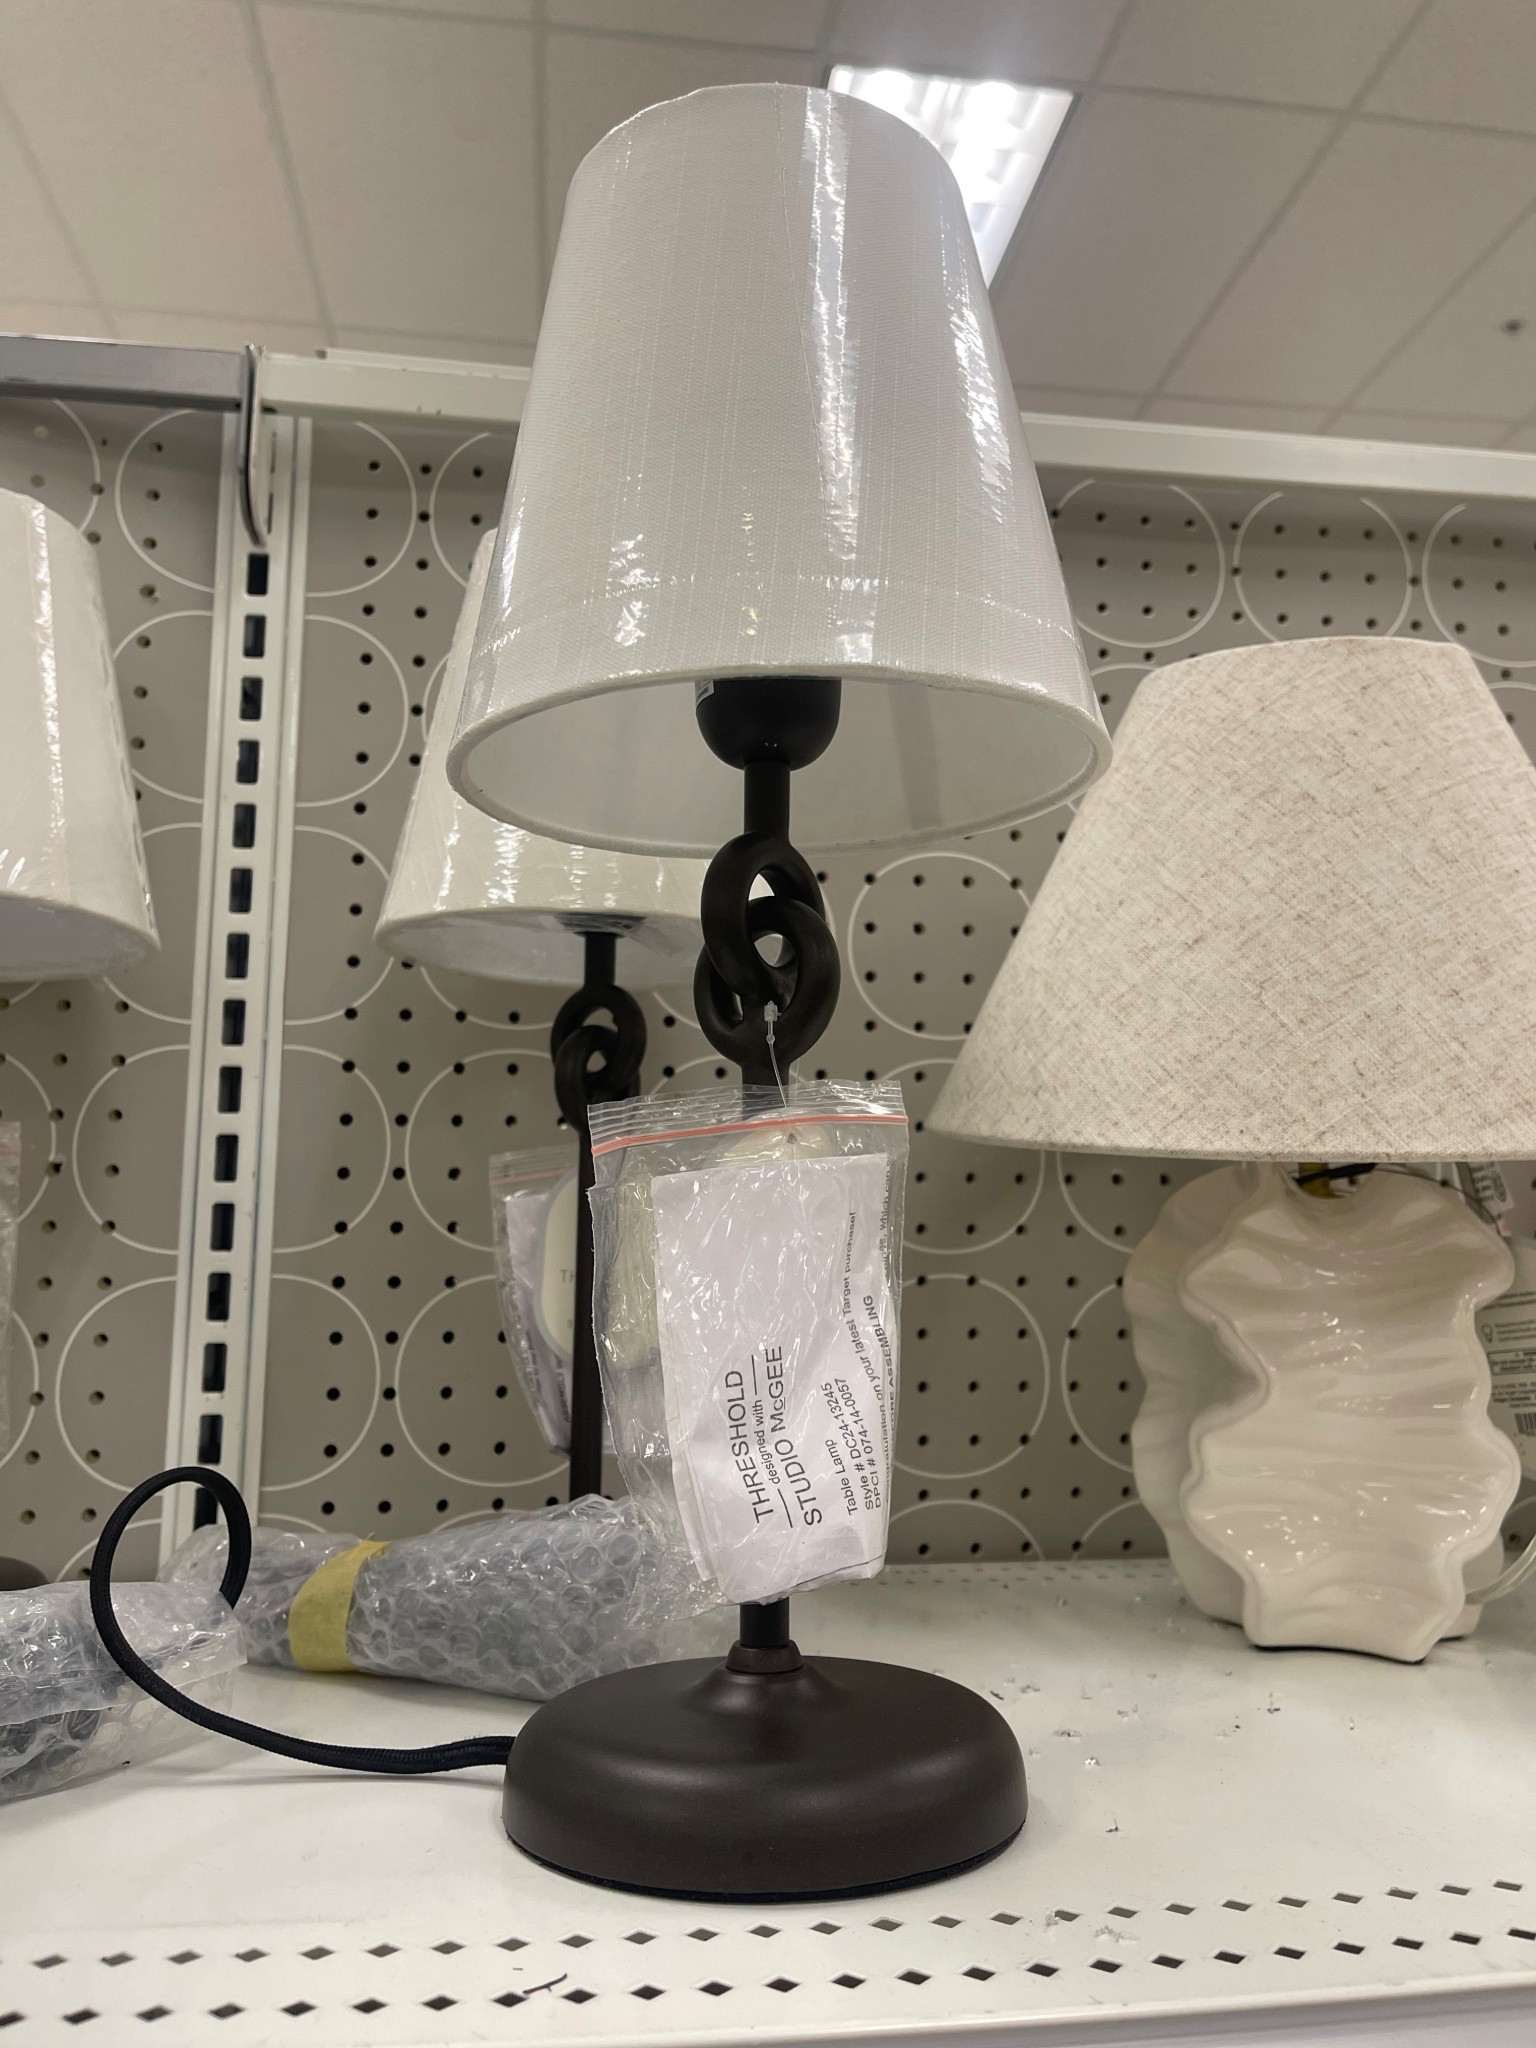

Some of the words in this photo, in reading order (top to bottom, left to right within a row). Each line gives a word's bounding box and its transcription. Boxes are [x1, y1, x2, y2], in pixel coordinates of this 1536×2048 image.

[844, 1212, 856, 1273] purchase!
[842, 1276, 852, 1317] Target
[845, 1318, 865, 1354] latest
[863, 1295, 894, 1387] ASSEMBLING
[860, 1356, 880, 1382] your
[765, 1346, 786, 1433] McGEE
[873, 1385, 884, 1400] on
[752, 1400, 764, 1426] with
[821, 1382, 862, 1460] DC24-13245
[834, 1378, 873, 1454] 074-14-0057
[725, 1370, 774, 1523] THRESHOLD
[754, 1430, 781, 1485] designed
[825, 1439, 846, 1475] Lamp
[866, 1458, 877, 1467] #
[774, 1439, 823, 1526] STUDIO
[855, 1462, 865, 1473] #
[840, 1477, 858, 1516] Table
[860, 1475, 874, 1510] Style
[869, 1471, 882, 1508] DPCI
